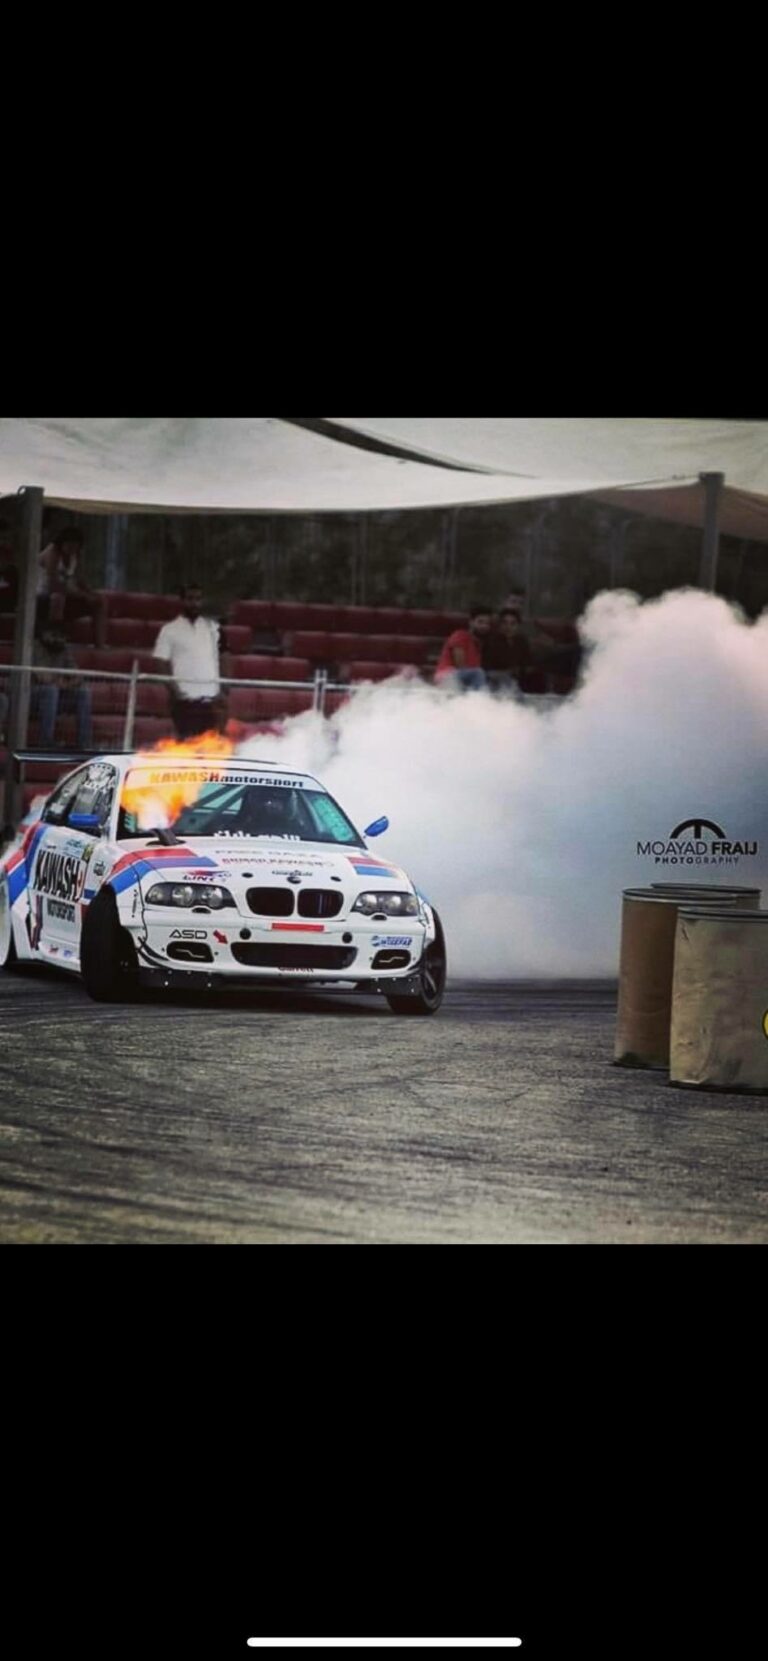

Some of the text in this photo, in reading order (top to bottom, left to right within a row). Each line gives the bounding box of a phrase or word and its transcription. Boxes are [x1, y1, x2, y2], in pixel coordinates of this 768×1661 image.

[221, 774, 304, 787] motorsport
[34, 850, 81, 901] KAWASH
[169, 929, 207, 939] ASD
